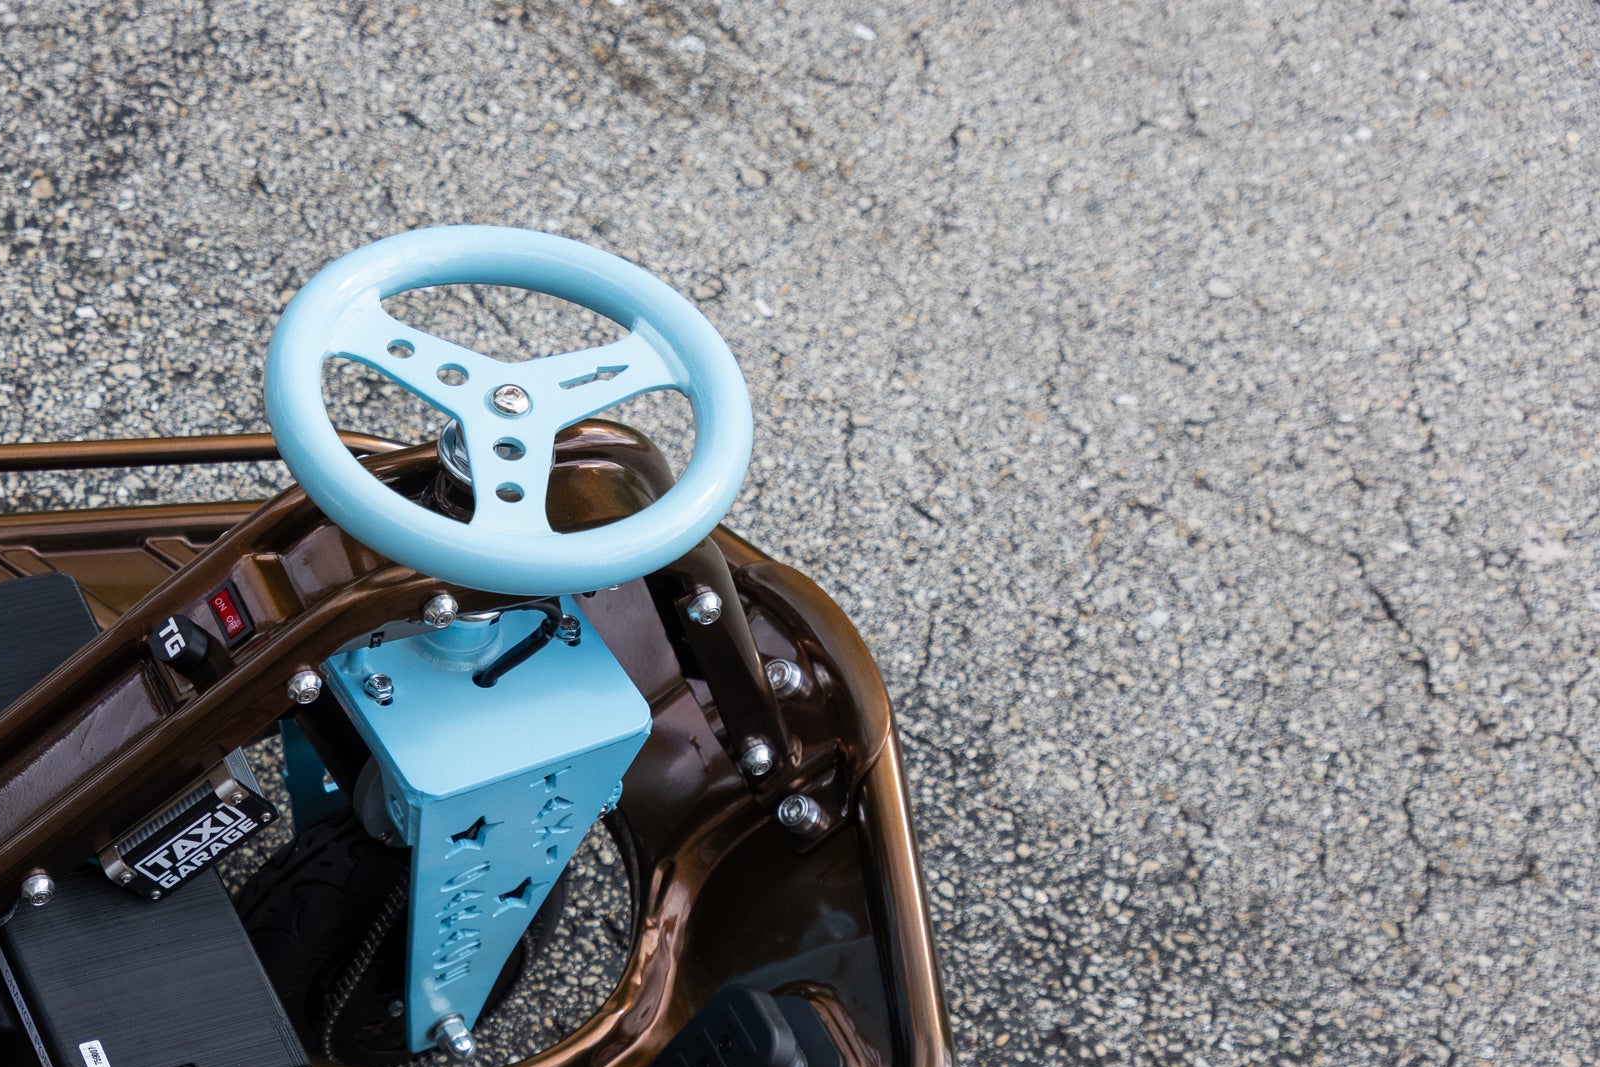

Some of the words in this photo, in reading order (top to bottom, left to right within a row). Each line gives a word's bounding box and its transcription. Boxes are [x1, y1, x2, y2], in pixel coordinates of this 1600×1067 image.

[214, 597, 227, 611] ON
[226, 615, 239, 630] OFF
[158, 616, 186, 658] TG
[145, 810, 235, 869] TAXI
[530, 765, 574, 865] TAXI
[159, 818, 258, 889] GARAGE
[5, 969, 34, 1034] CHARGE
